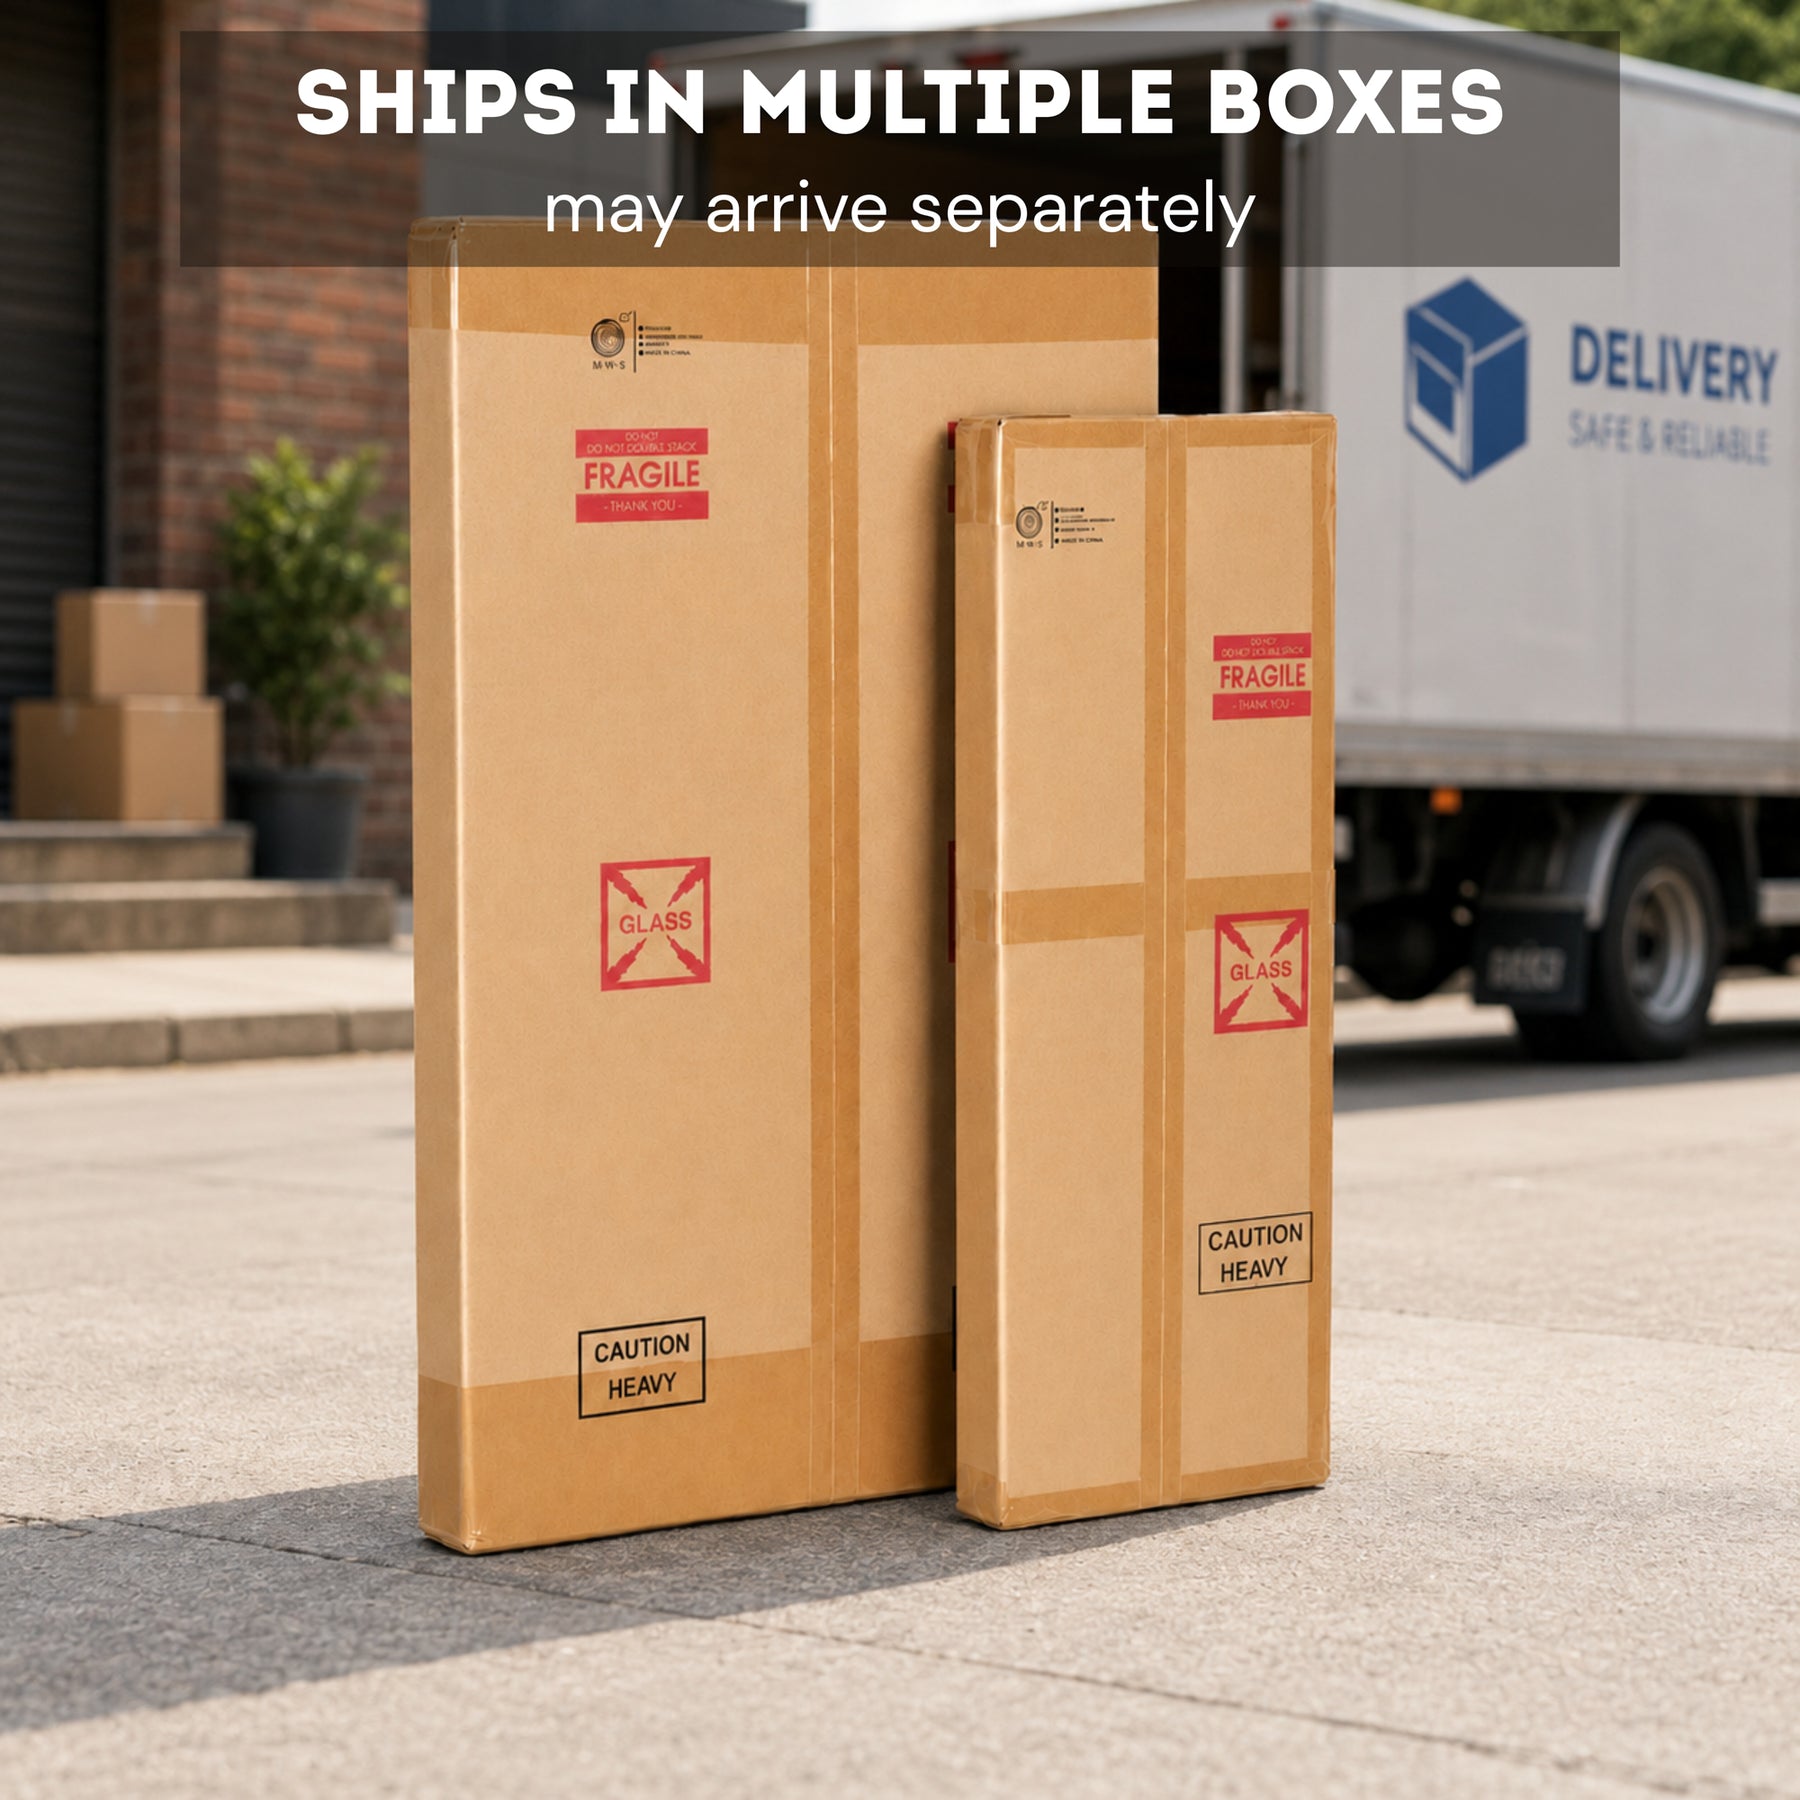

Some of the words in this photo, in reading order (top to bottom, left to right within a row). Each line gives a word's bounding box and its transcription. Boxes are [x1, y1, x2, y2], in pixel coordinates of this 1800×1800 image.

[1571, 322, 1778, 405] DELIVERY
[587, 443, 602, 454] DO
[605, 443, 624, 453] NOT
[1569, 408, 1631, 452] SAFE
[1661, 418, 1771, 466] RELIABLE
[584, 460, 700, 490] FRAGILE
[610, 500, 649, 512] THANK
[651, 499, 676, 511] YOU
[1220, 664, 1306, 689] FRAGILE
[1270, 698, 1290, 709] YOU
[619, 911, 692, 934] GLASS
[1230, 960, 1292, 981] GLASS
[1208, 1222, 1303, 1251] CAUTION
[1221, 1256, 1288, 1283] HEAVY
[594, 1332, 690, 1363] CAUTION
[609, 1371, 677, 1400] HEAVY
